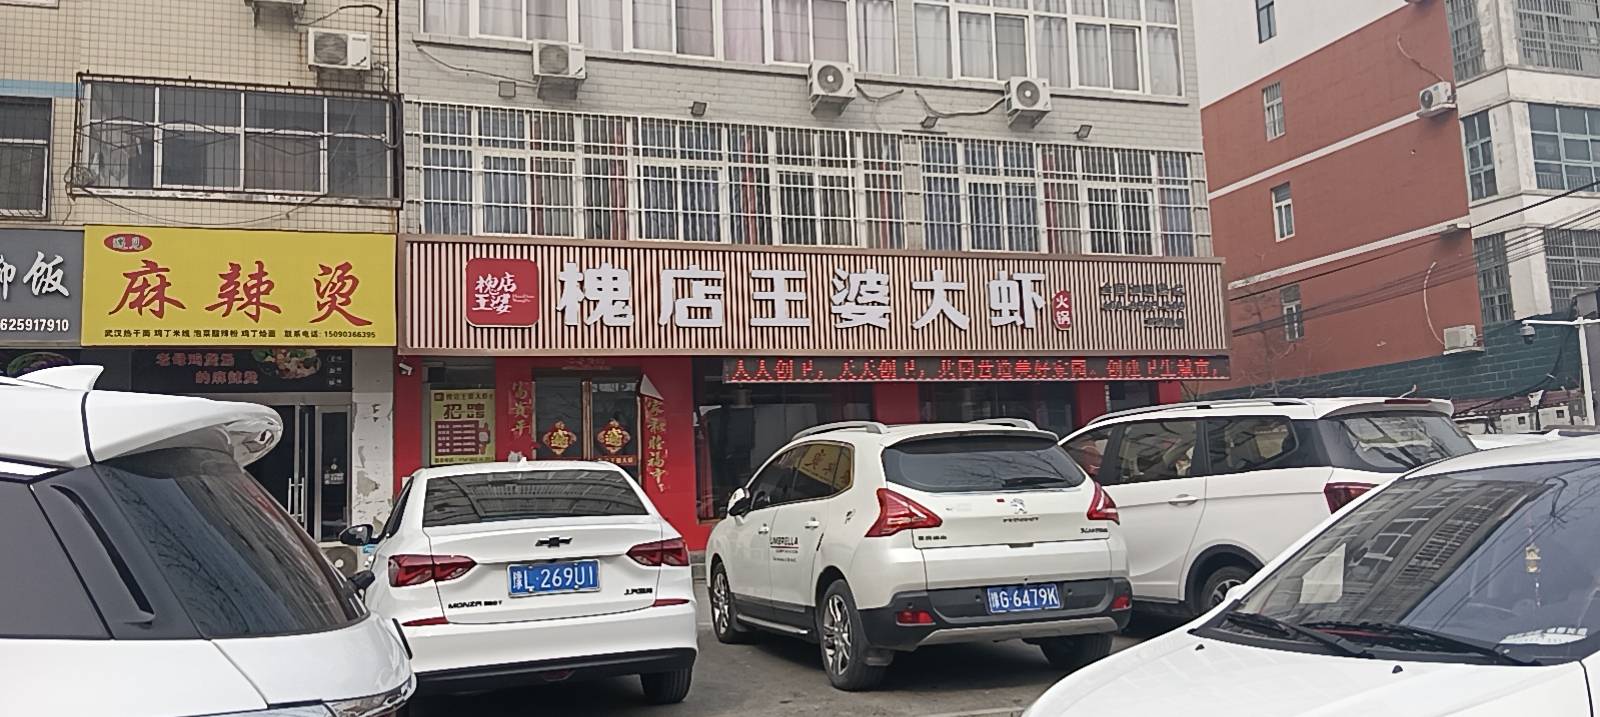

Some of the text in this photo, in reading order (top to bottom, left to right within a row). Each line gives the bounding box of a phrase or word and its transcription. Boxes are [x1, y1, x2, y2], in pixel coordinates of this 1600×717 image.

[108, 259, 373, 326] 麻辣烫
[475, 272, 517, 295] 槐店
[556, 262, 1047, 331] 槐店王婆大虾
[472, 293, 513, 315] 王婆
[1055, 294, 1070, 325] 火锅
[104, 329, 151, 338] 武汉热干面
[153, 329, 190, 338] 鸡丁米线
